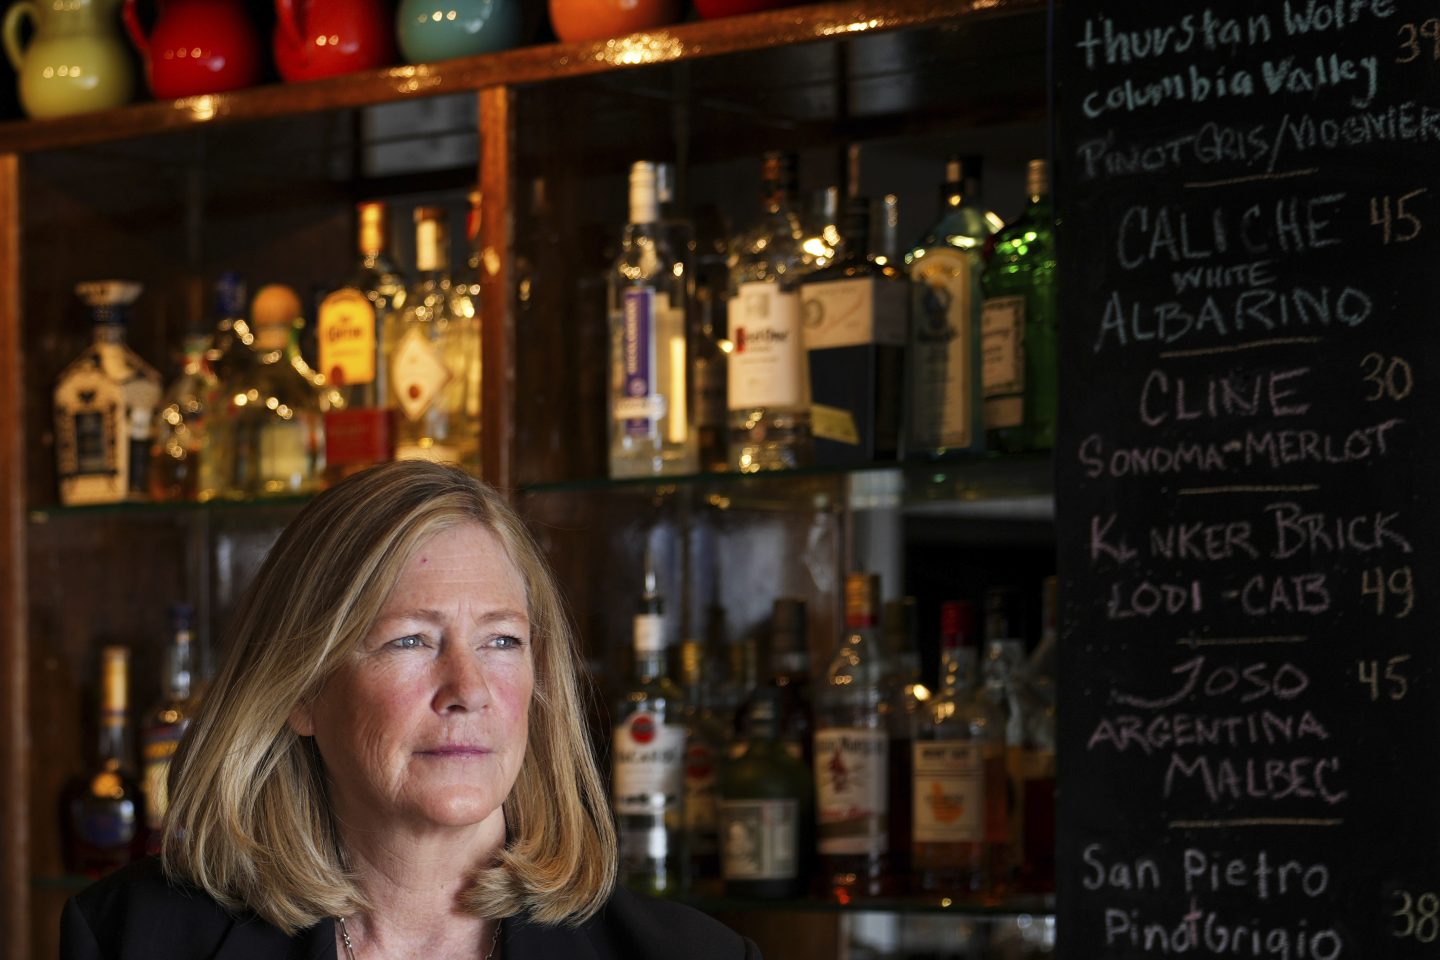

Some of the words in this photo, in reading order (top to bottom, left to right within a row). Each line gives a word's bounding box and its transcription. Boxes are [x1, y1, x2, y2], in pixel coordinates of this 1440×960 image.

[1076, 8, 1272, 69] thurstan
[1082, 63, 1254, 119] columbia
[1262, 53, 1379, 109] Valley
[1117, 192, 1347, 270] CALICHE
[1369, 187, 1428, 245] 45
[1171, 259, 1278, 295] WHITE
[1093, 286, 1373, 353] ALBARINO
[1139, 366, 1311, 427] CLINE
[1360, 352, 1414, 402] 30
[1078, 418, 1407, 479] SONOMA-MERLOT
[1090, 511, 1259, 564] KLNKER
[1264, 501, 1413, 559] BRICK
[1108, 578, 1204, 620] LODI
[1361, 565, 1414, 618] 49
[1358, 654, 1412, 701] 45
[1086, 710, 1331, 753] ARGENTINA
[1163, 753, 1349, 804] MALBEC
[1081, 843, 1161, 891] San
[1182, 848, 1330, 900] Pietro
[1391, 889, 1440, 943] 38
